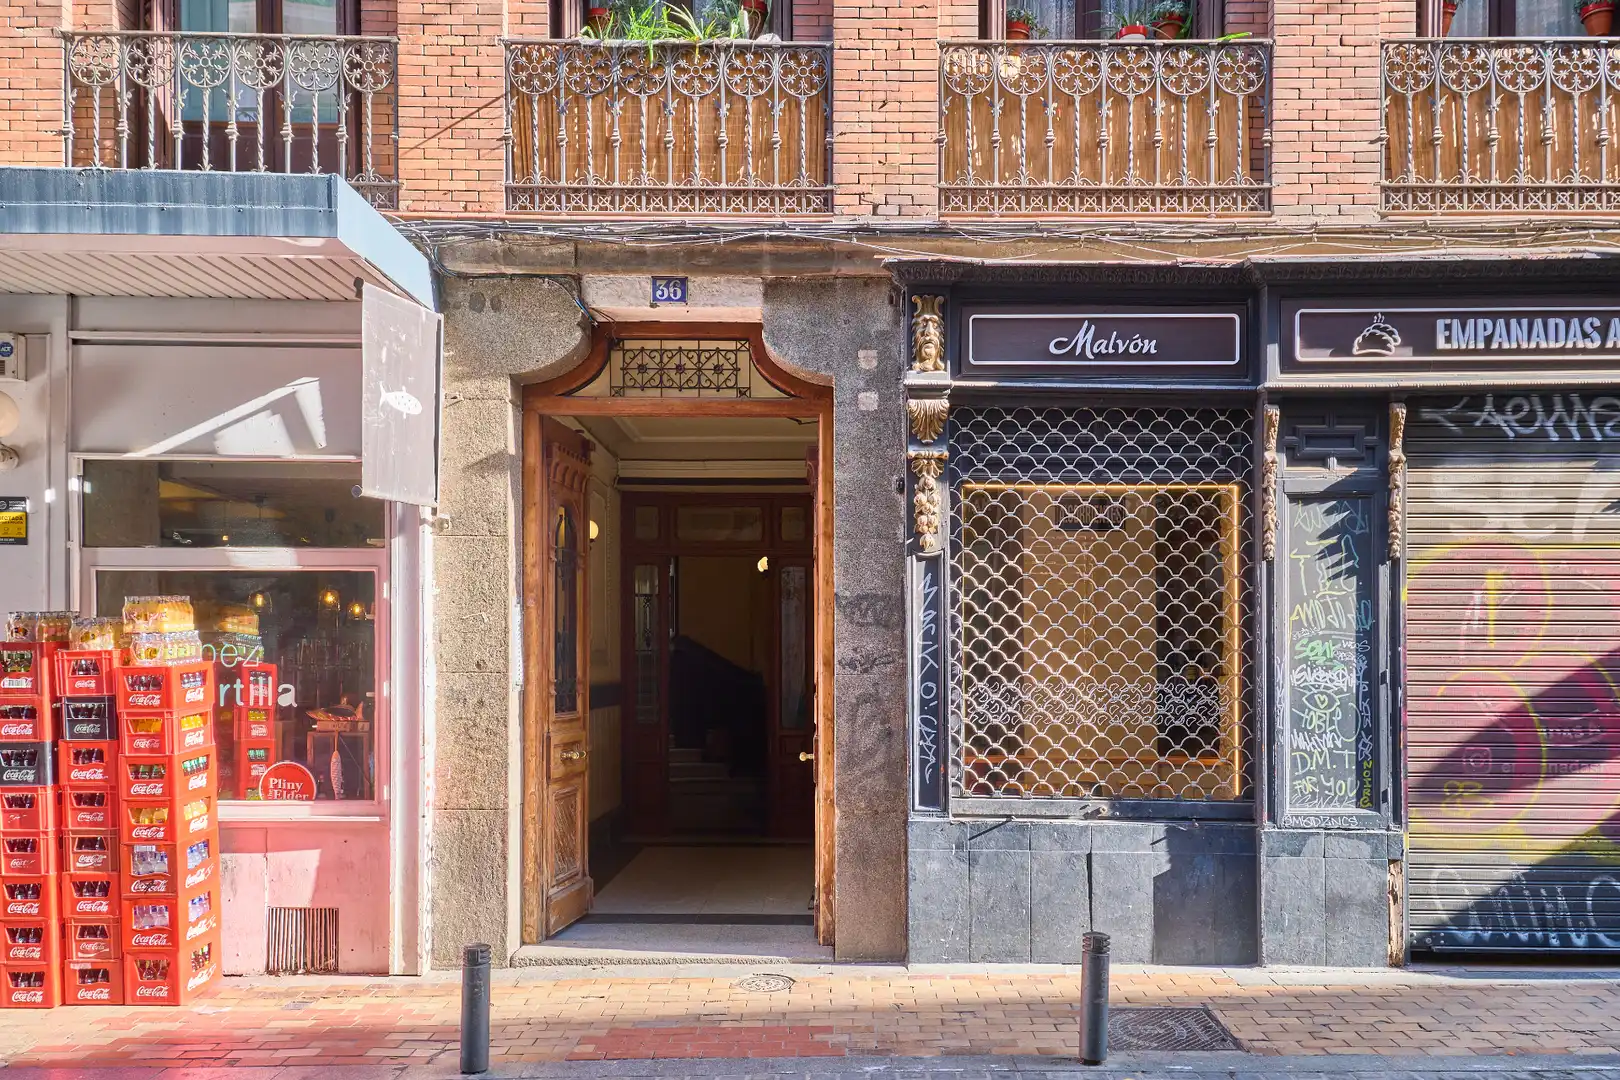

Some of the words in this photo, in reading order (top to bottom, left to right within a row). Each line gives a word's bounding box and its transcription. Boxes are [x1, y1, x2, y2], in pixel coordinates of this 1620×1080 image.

[655, 279, 682, 300] 36
[1049, 319, 1158, 359] Malvón
[1436, 316, 1601, 350] EMPANADAS
[219, 676, 298, 707] rtilla
[268, 777, 304, 793] Pliny
[273, 789, 310, 800] Elder
[1320, 774, 1361, 797] YOU
